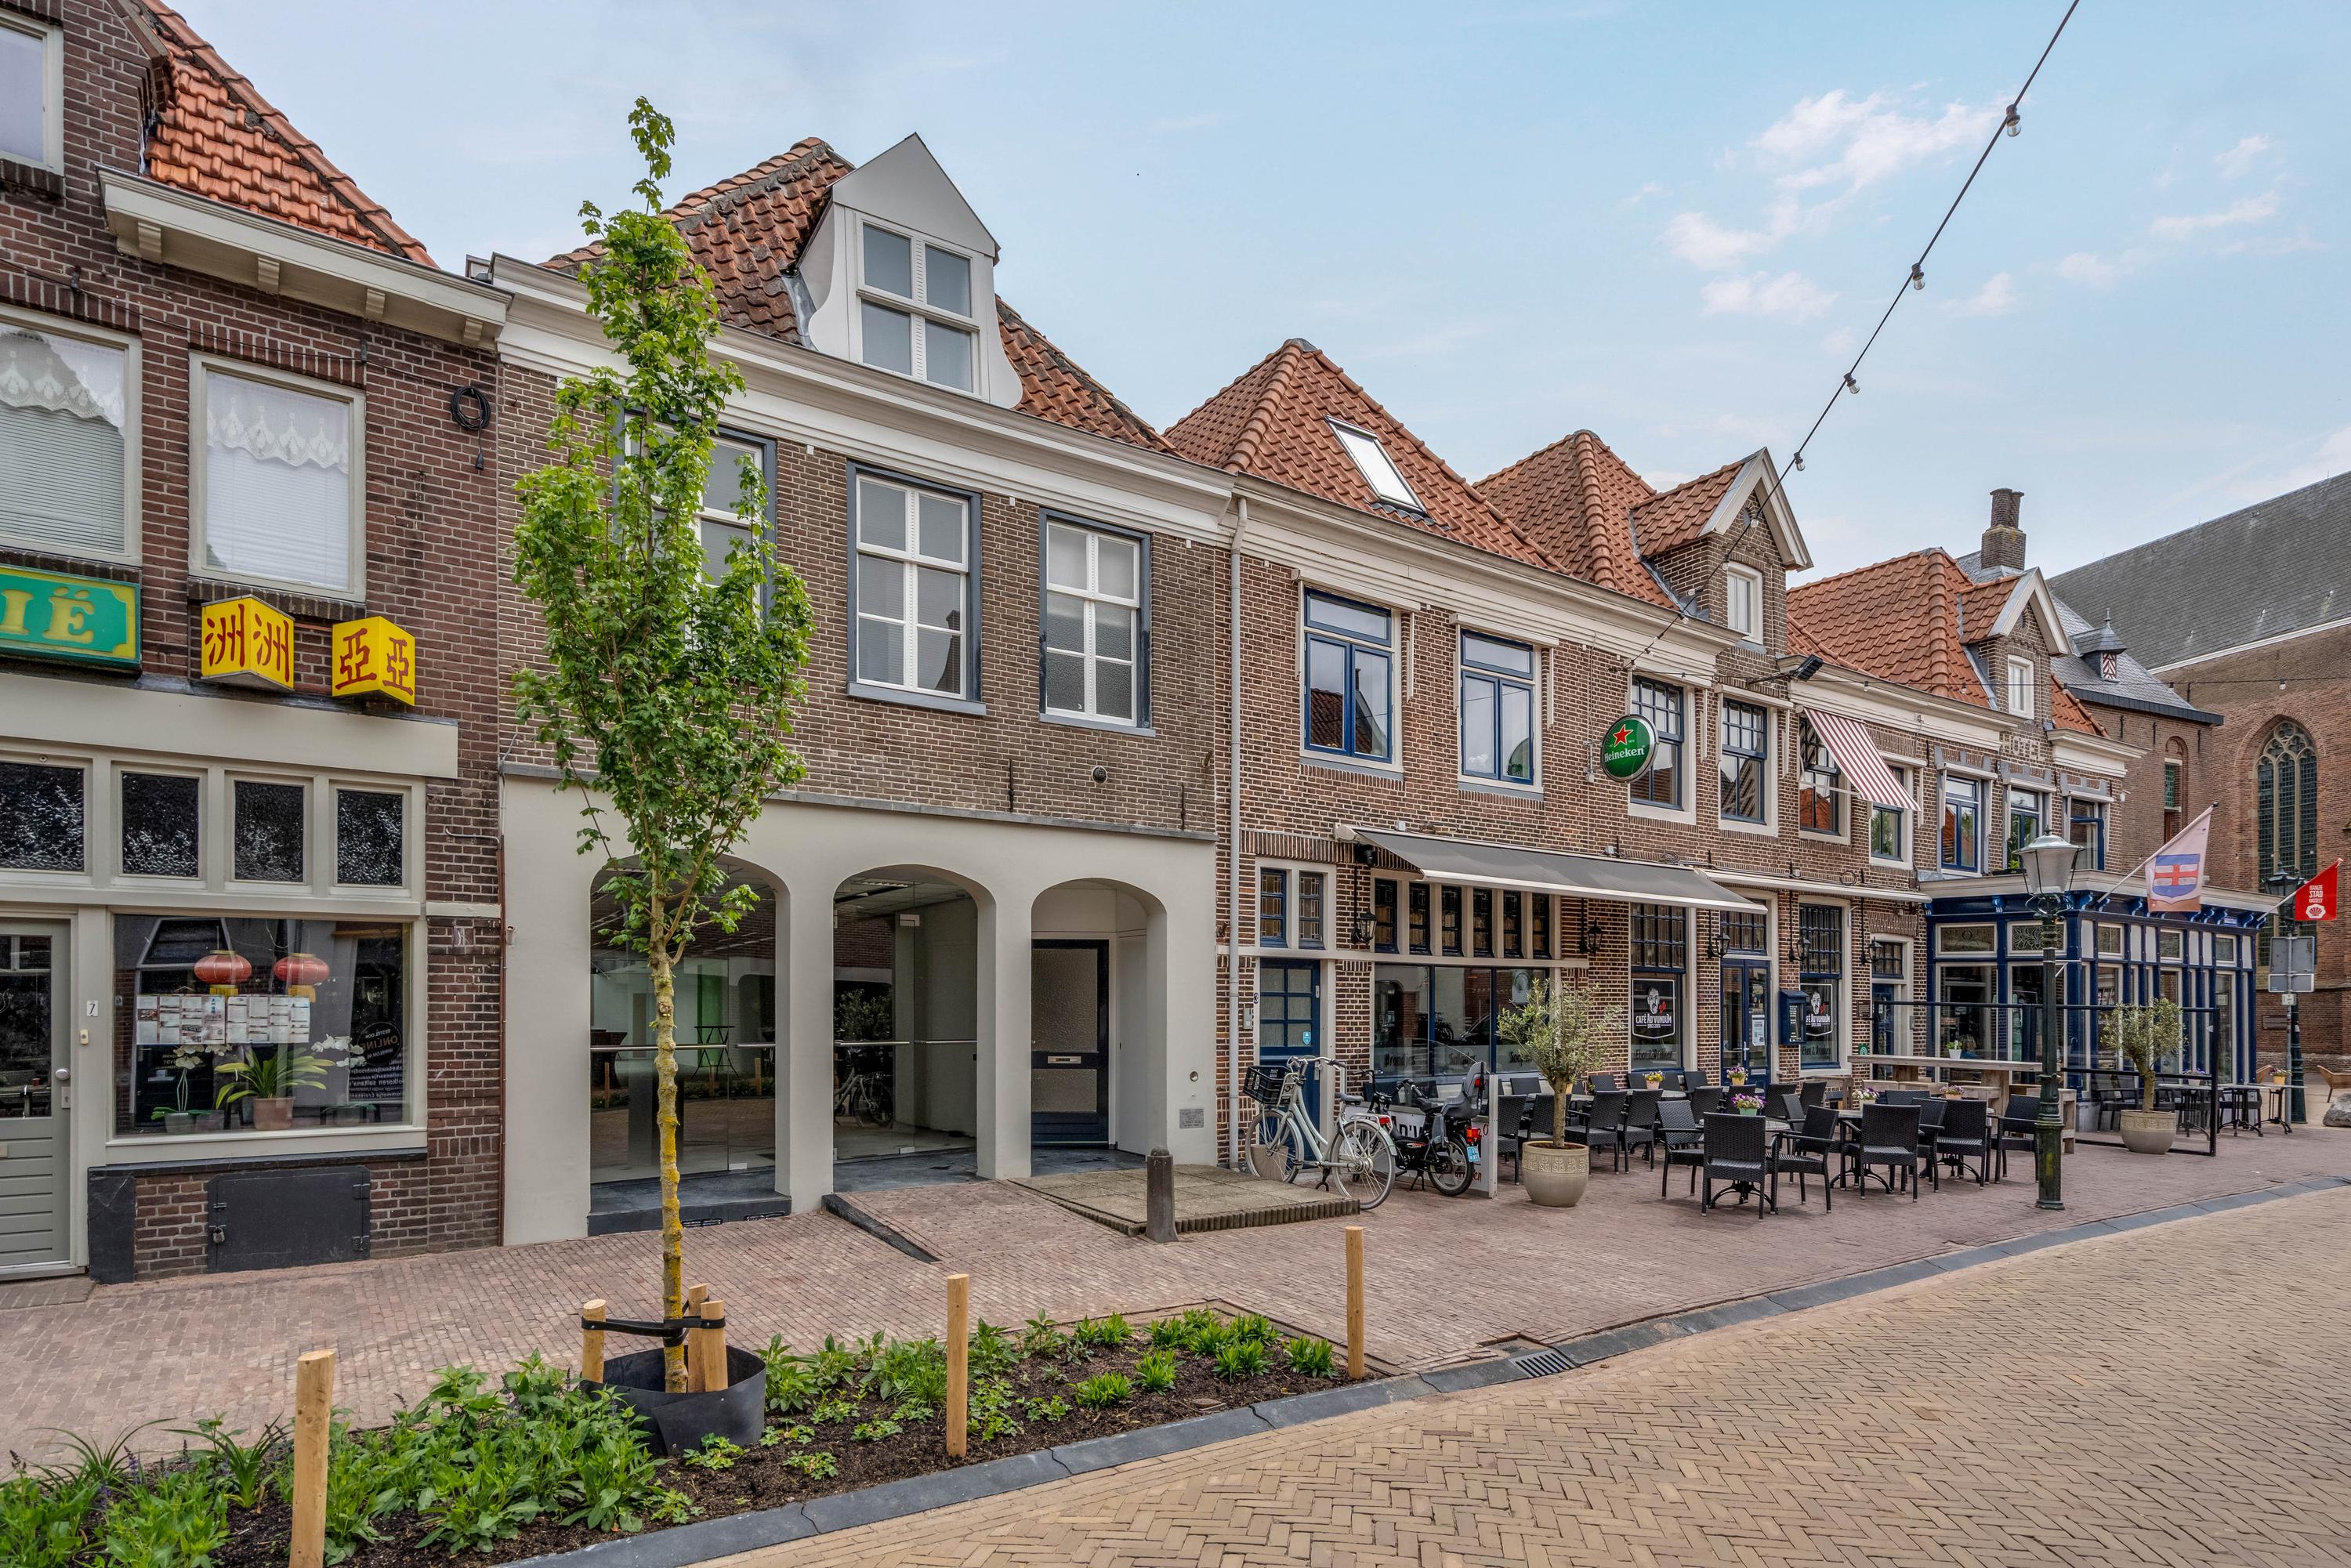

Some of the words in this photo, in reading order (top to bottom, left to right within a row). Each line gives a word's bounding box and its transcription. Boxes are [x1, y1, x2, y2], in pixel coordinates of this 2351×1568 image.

[205, 603, 245, 668] 洲
[253, 614, 289, 683] 洲
[335, 628, 377, 690] 亞
[382, 636, 413, 696] 亞
[1604, 748, 1645, 762] Heineken
[89, 1003, 96, 1015] 7
[1254, 993, 1259, 1004] 3
[1636, 1014, 1646, 1023] CAFÉ
